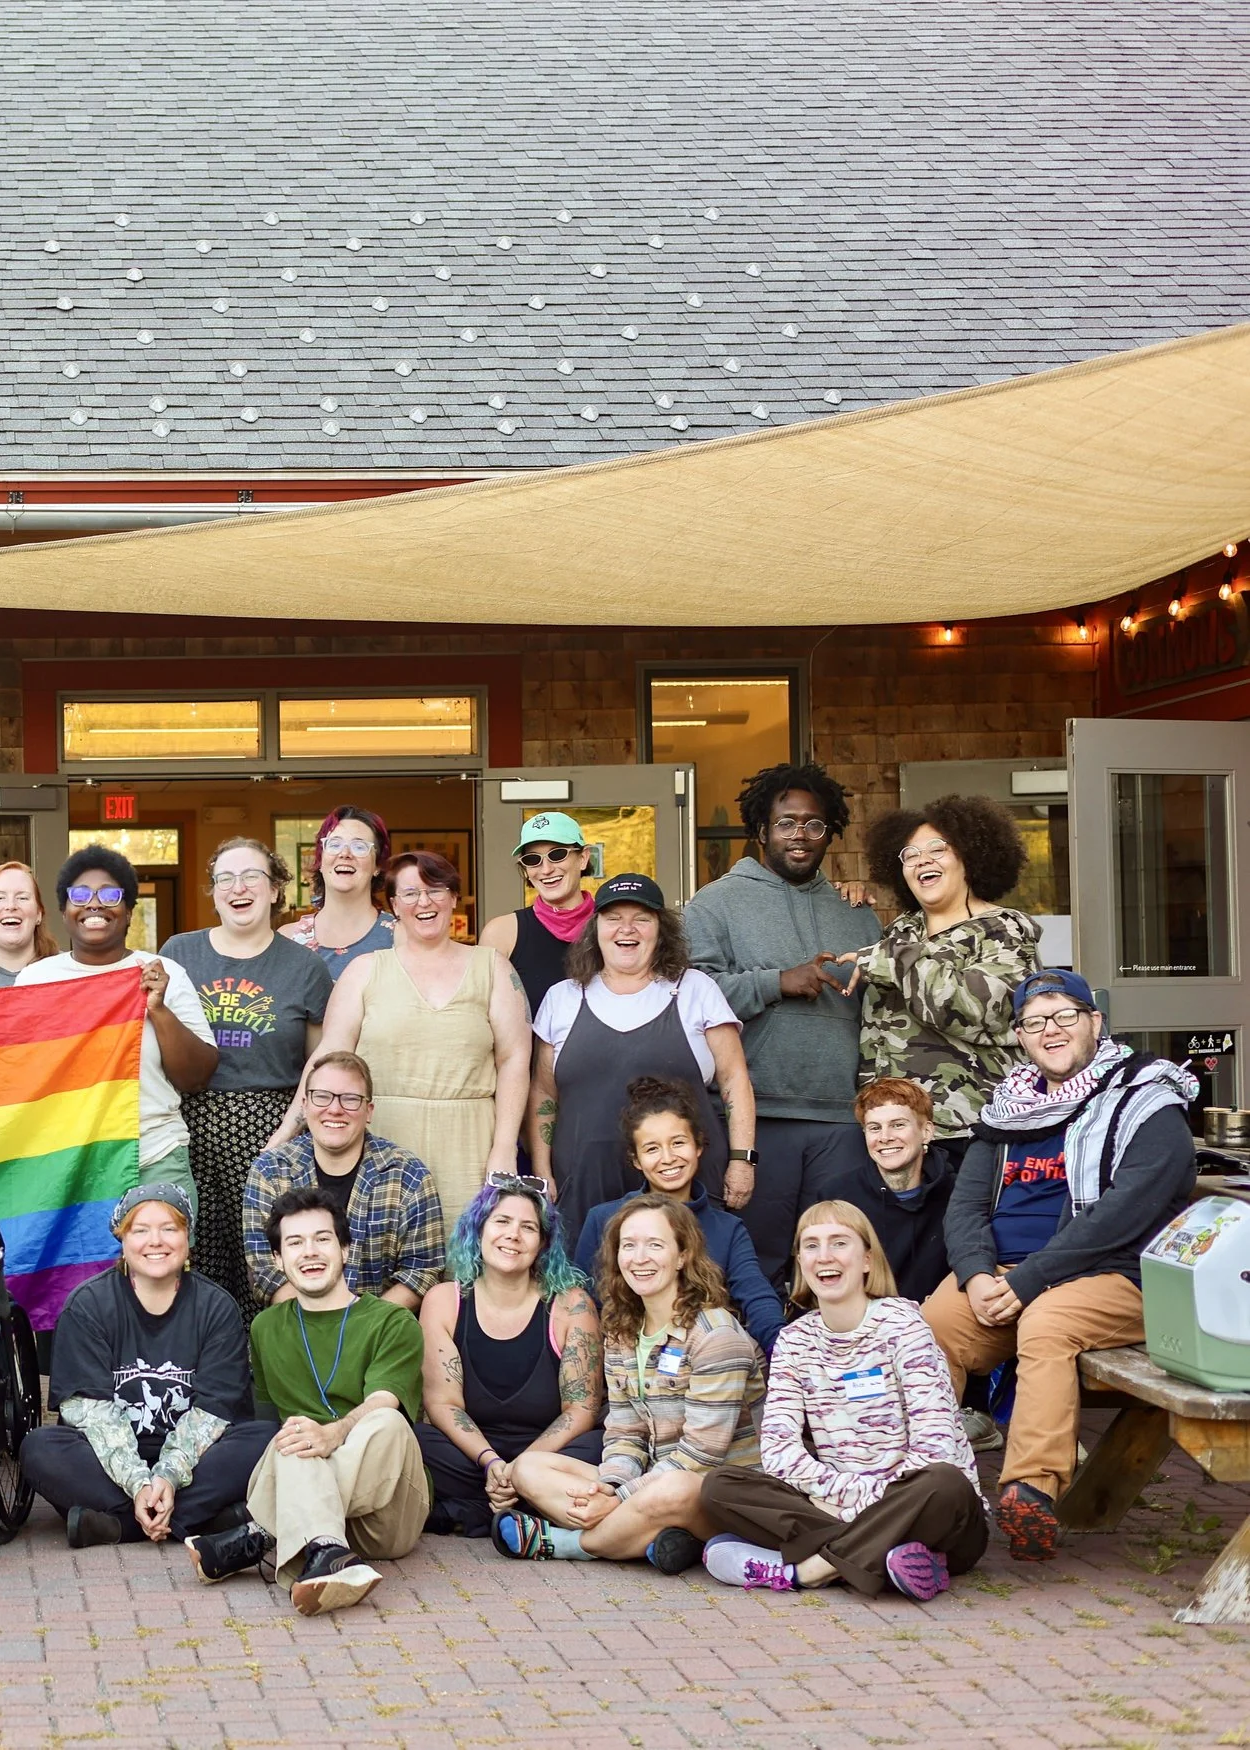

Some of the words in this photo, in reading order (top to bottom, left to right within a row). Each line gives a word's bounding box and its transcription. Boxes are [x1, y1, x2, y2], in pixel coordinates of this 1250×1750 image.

[105, 796, 135, 819] EXIT
[201, 977, 235, 996] LET
[236, 978, 264, 998] ME
[218, 992, 241, 1006] BE
[203, 1006, 276, 1037] RFECTLY
